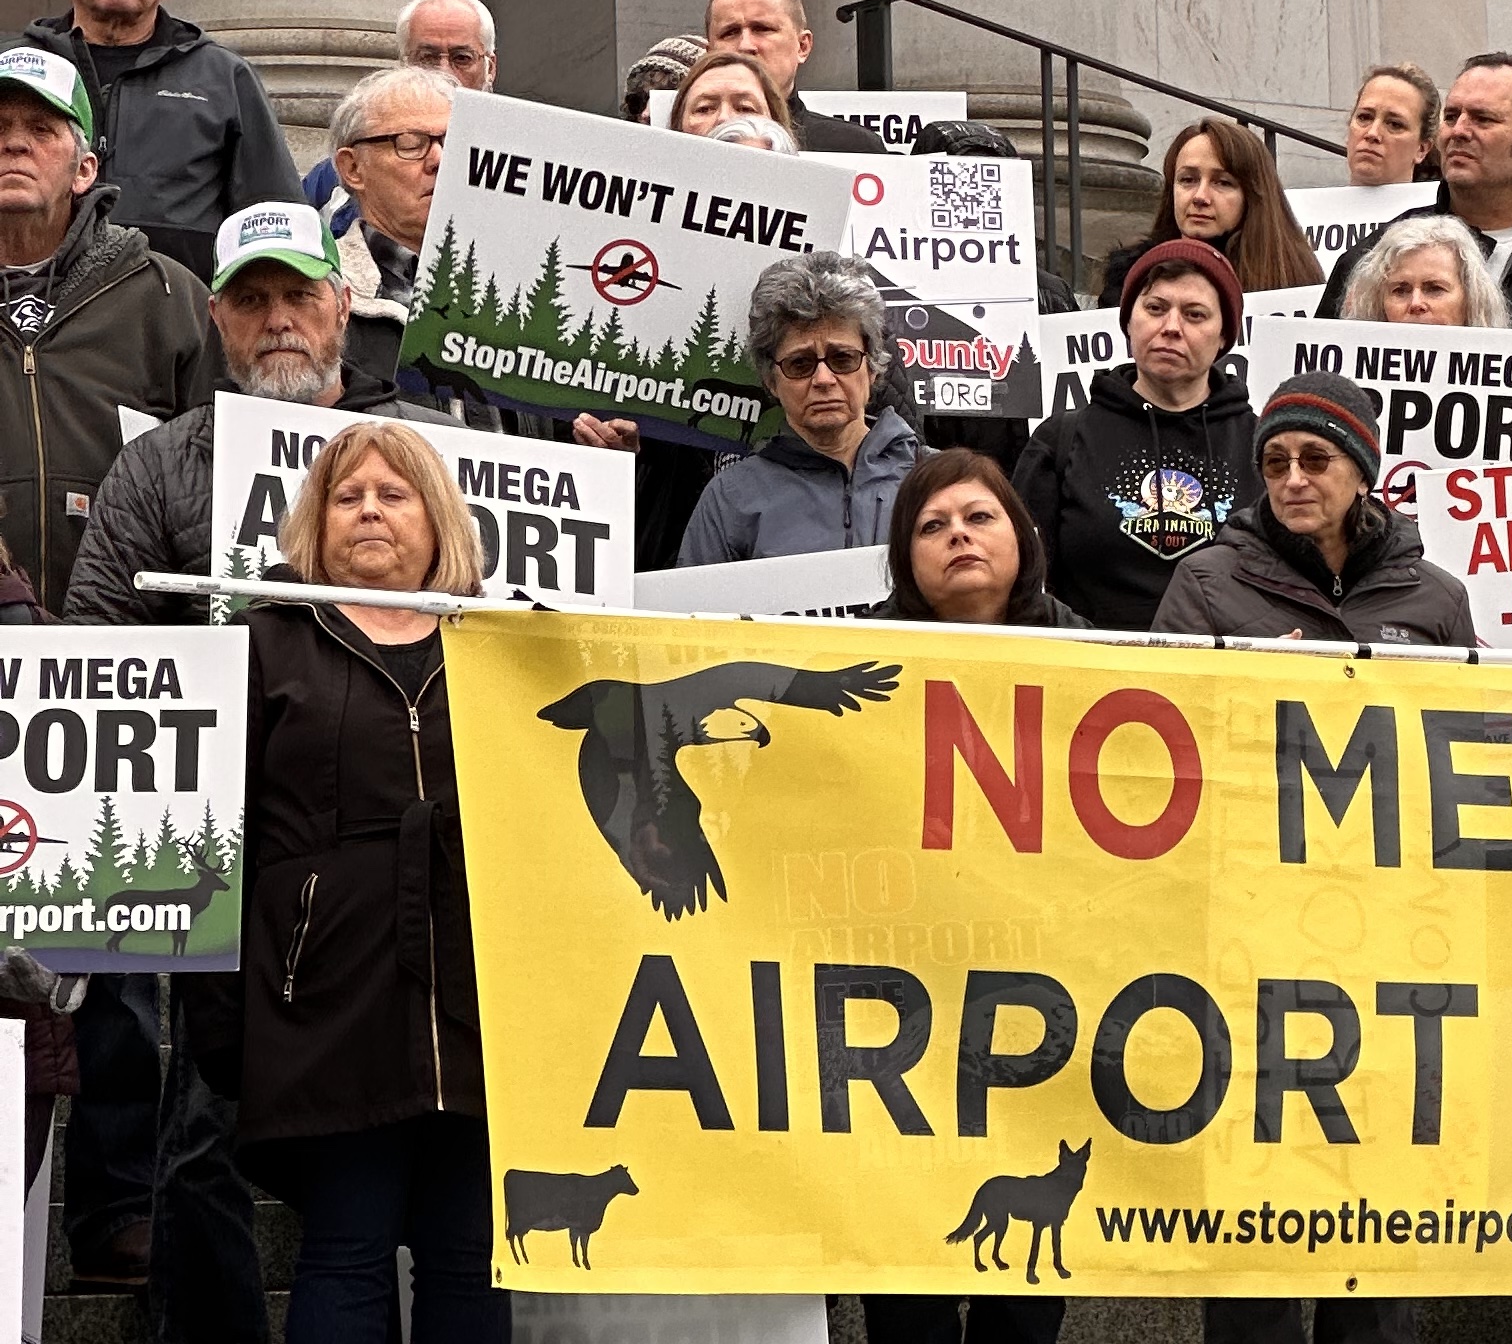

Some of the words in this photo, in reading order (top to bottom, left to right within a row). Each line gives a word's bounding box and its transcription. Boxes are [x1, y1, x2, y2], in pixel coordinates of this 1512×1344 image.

[833, 114, 923, 144] EGA
[467, 146, 532, 196] WE
[541, 161, 674, 224] WON'T
[681, 191, 815, 254] LEAVE.
[865, 227, 1021, 270] Airport
[1306, 222, 1388, 251] WON'
[897, 335, 1015, 381] ounty
[1066, 332, 1113, 364] NO
[1295, 343, 1343, 374] NO
[1356, 347, 1437, 382] NEW
[441, 332, 761, 424] StopTheAirport.com
[458, 457, 581, 511] MEGA
[1151, 534, 1188, 547] SOUT
[39, 658, 183, 700] MEGA
[921, 680, 1203, 860] NO
[582, 955, 1478, 1147] AIRPORT
